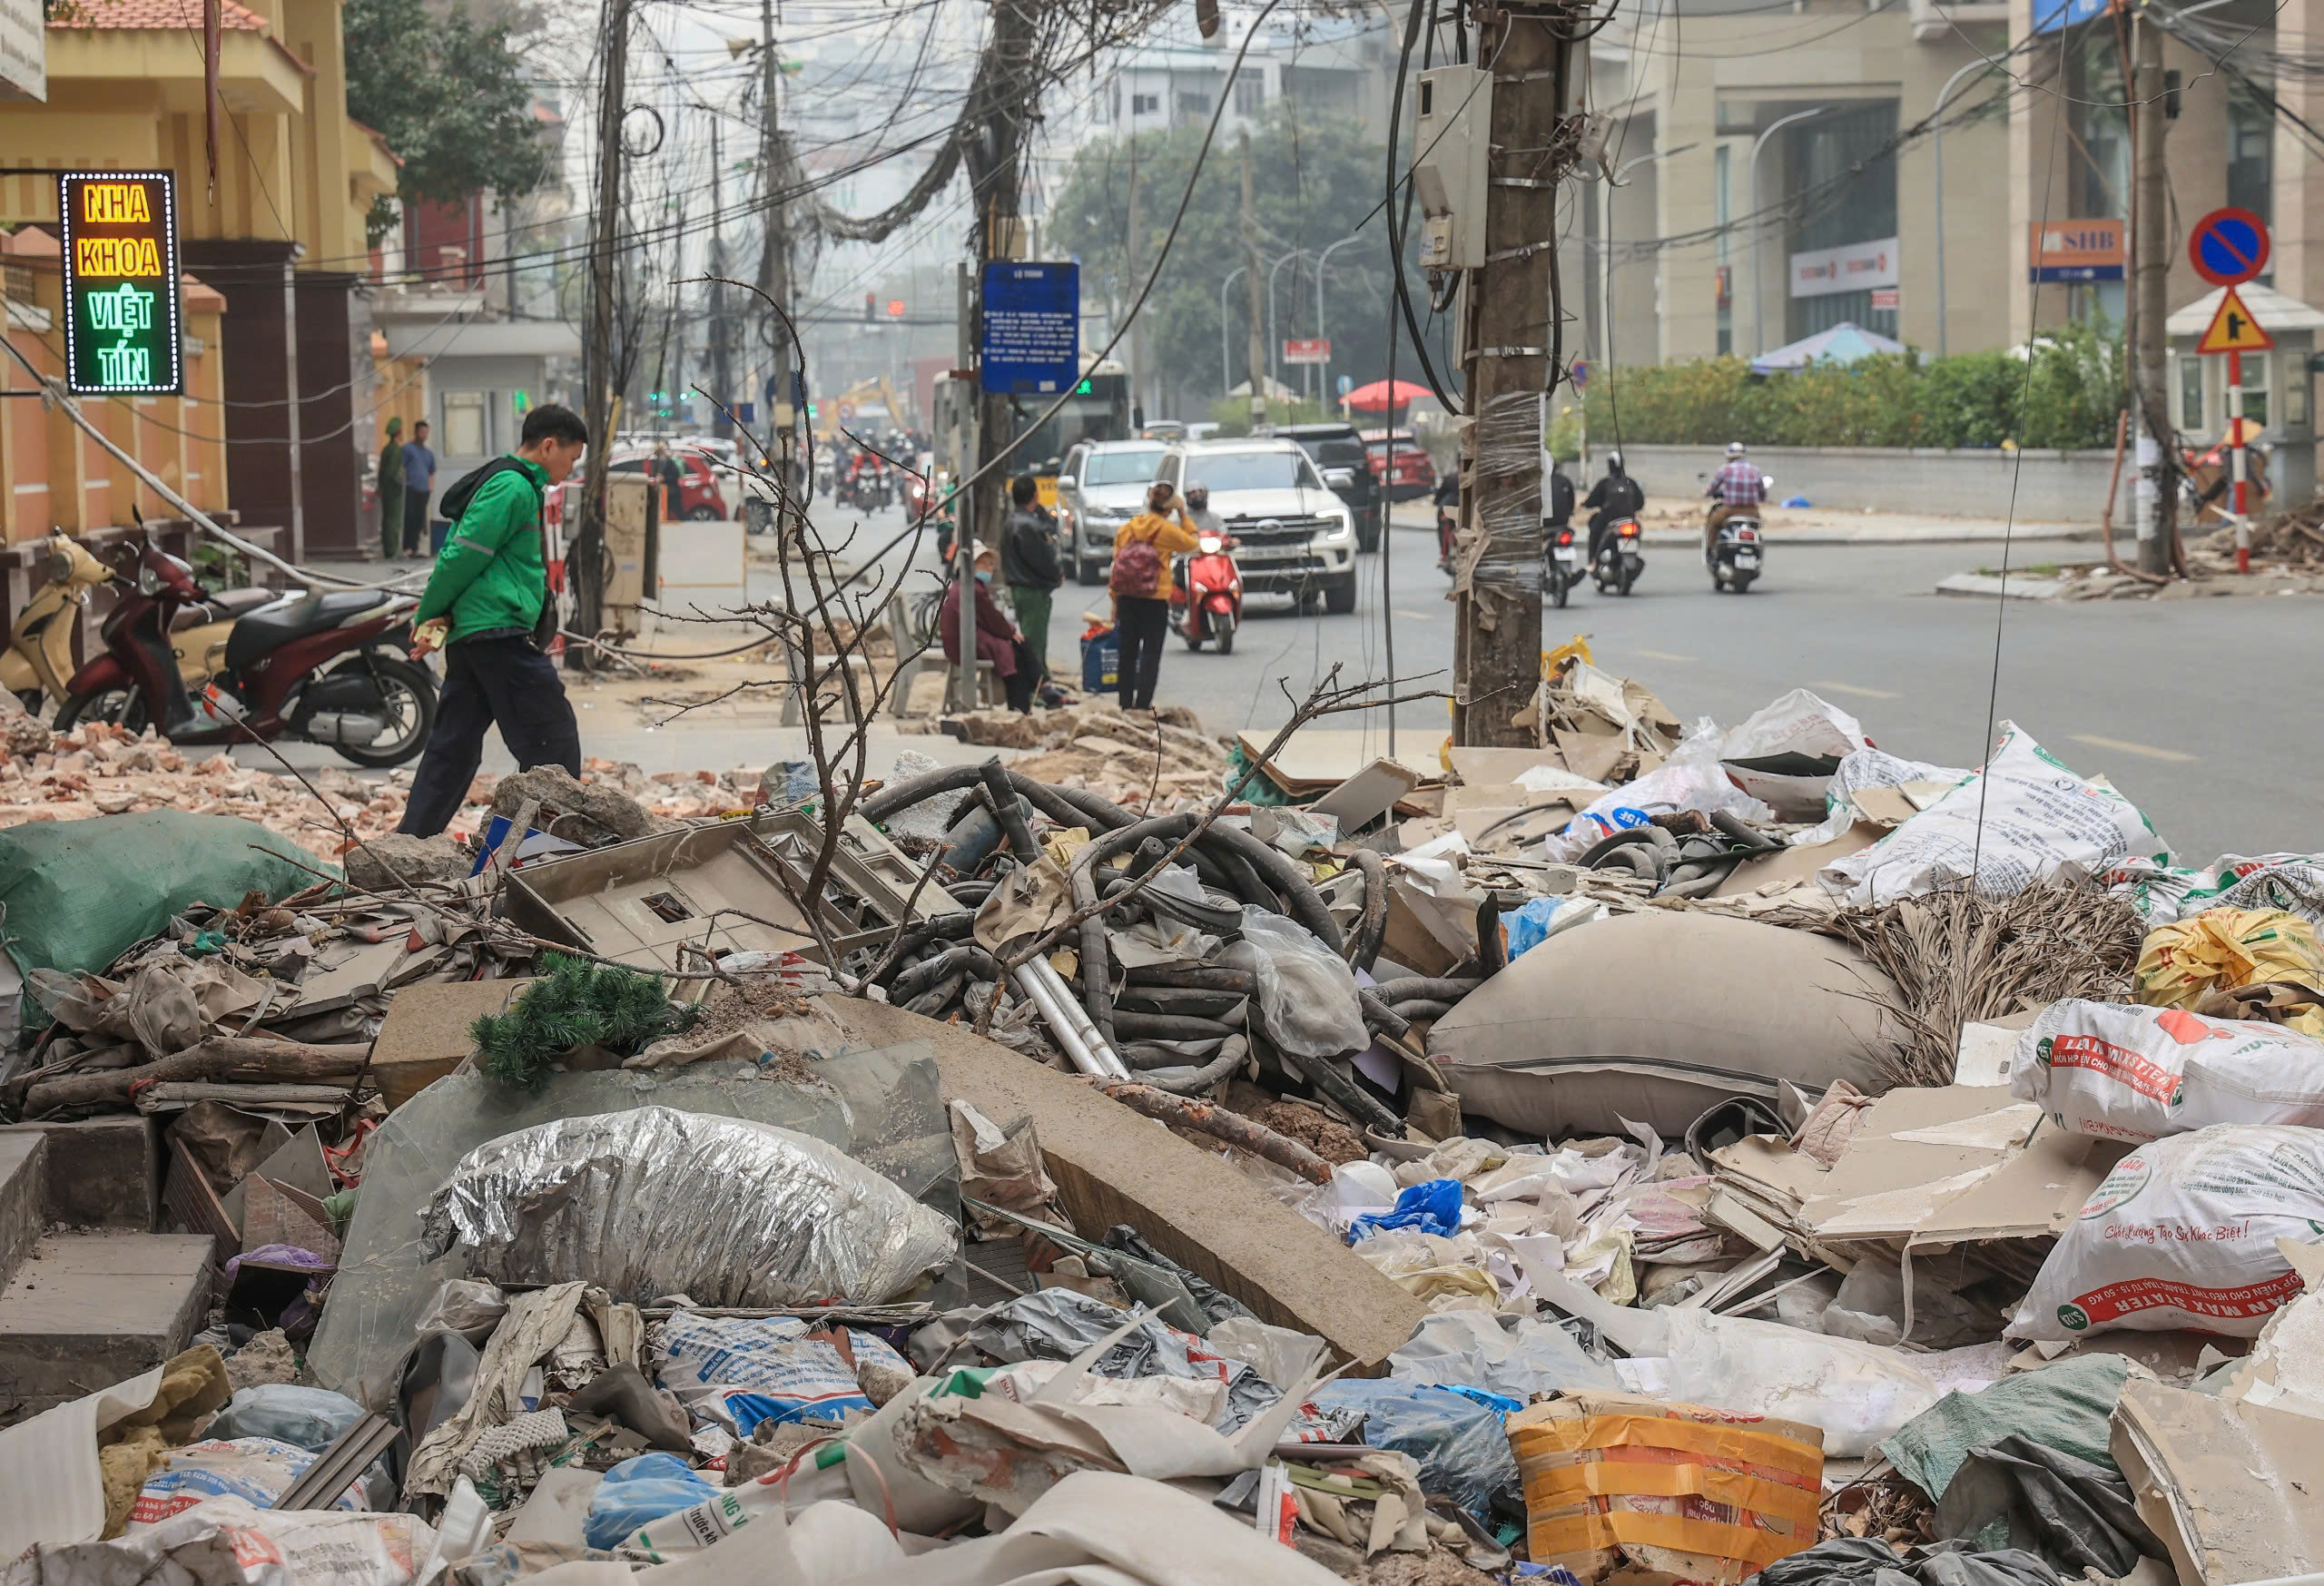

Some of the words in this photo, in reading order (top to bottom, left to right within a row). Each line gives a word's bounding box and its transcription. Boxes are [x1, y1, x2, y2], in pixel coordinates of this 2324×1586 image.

[84, 184, 151, 222] NHA
[2063, 231, 2114, 250] SHB
[77, 238, 162, 276] KHOA
[87, 282, 154, 338] VIỆT
[97, 339, 150, 385] TÍN
[2089, 1056, 2110, 1070] CHO
[2156, 1089, 2170, 1100] KG
[2105, 1226, 2125, 1240] Chất
[2124, 1223, 2154, 1244] Lượng
[2160, 1225, 2173, 1241] Tạo
[2175, 1226, 2189, 1243] Sự
[2191, 1225, 2213, 1241] Khác
[2102, 1288, 2115, 1297] 50
[2118, 1285, 2131, 1293] 15
[2141, 1278, 2160, 1290] TRẠI
[2159, 1283, 2189, 1294] TRANG
[2251, 1283, 2281, 1295] VIÊN
[2086, 1292, 2103, 1305] KG
[2113, 1294, 2187, 1311] STATER
[2208, 1292, 2229, 1301] HEO
[2229, 1289, 2250, 1299] CHO
[2247, 1286, 2301, 1313] EAN
[2190, 1300, 2242, 1316] MAX
[700, 1349, 726, 1375] KHÁNG
[689, 1507, 709, 1534] trước
